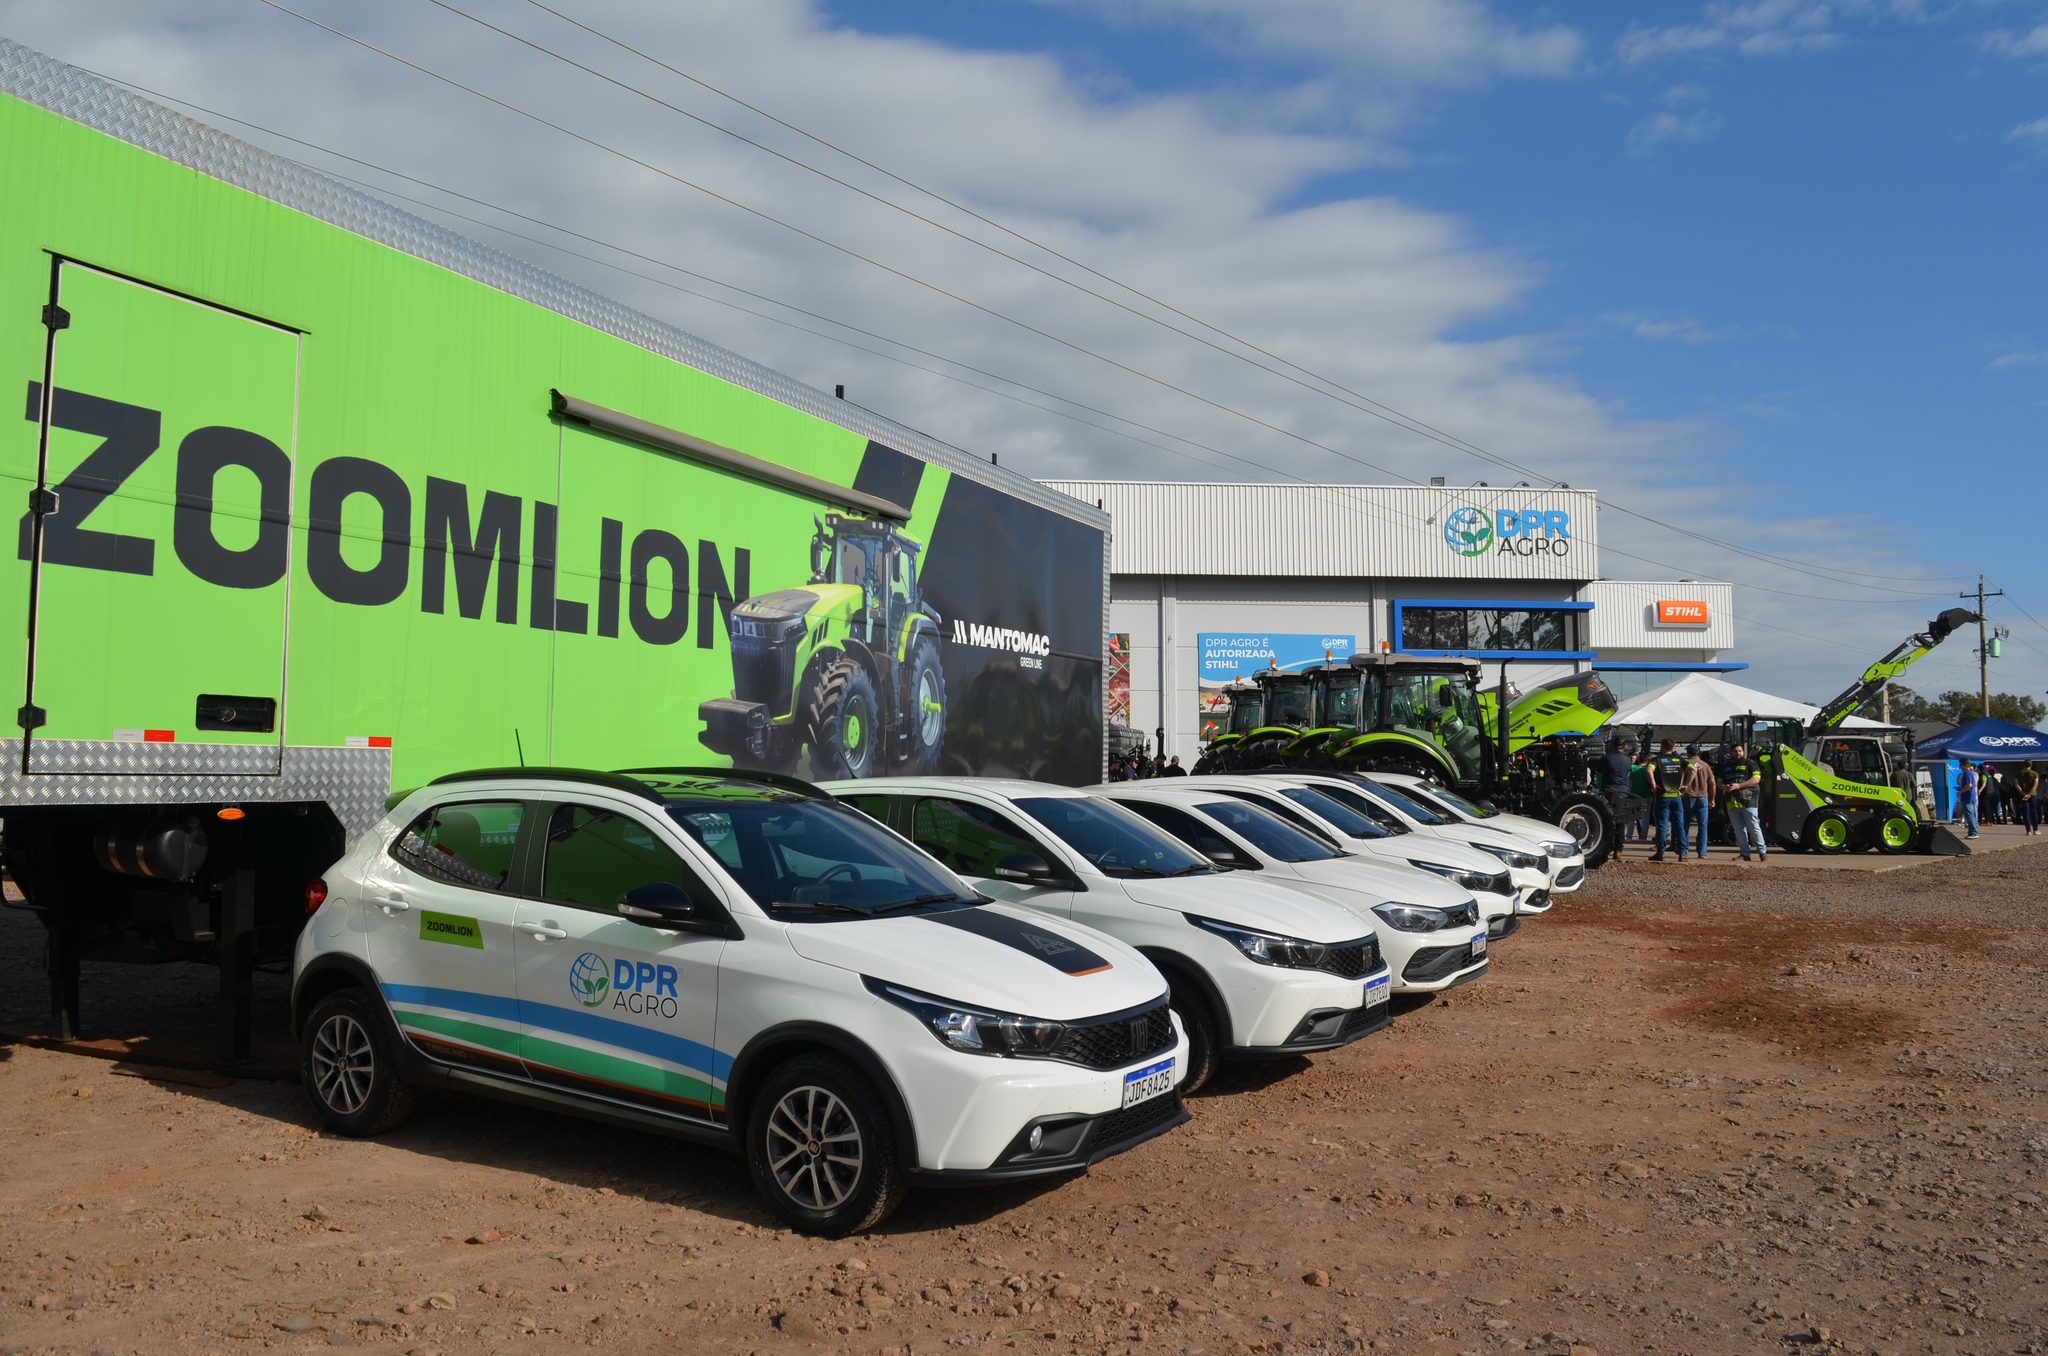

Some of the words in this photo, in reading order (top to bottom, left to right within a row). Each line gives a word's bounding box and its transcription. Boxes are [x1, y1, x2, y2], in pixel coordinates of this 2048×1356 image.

[17, 379, 751, 650] ZOOMLION
[1496, 509, 1570, 538] DPR
[1497, 537, 1569, 557] AGRO
[1665, 606, 1702, 617] STIHL
[969, 623, 1050, 657] MANTOMAC
[1205, 638, 1228, 647] DPR
[1229, 638, 1260, 647] AGRO
[1262, 637, 1269, 647] É
[1332, 638, 1348, 646] DPR
[1205, 649, 1276, 658] AUTORIZADA
[1020, 657, 1034, 668] GREEN
[1034, 658, 1042, 670] LINE
[1205, 660, 1239, 669] STIHL!
[1826, 700, 1859, 727] ZOOMLION
[2000, 736, 2037, 745] DPR
[1832, 782, 1880, 795] ZOOMLION
[427, 921, 473, 938] ZOOMLION
[613, 959, 679, 998] DPR
[613, 990, 678, 1019] AGRO
[1128, 1070, 1171, 1103] JDF8A25
